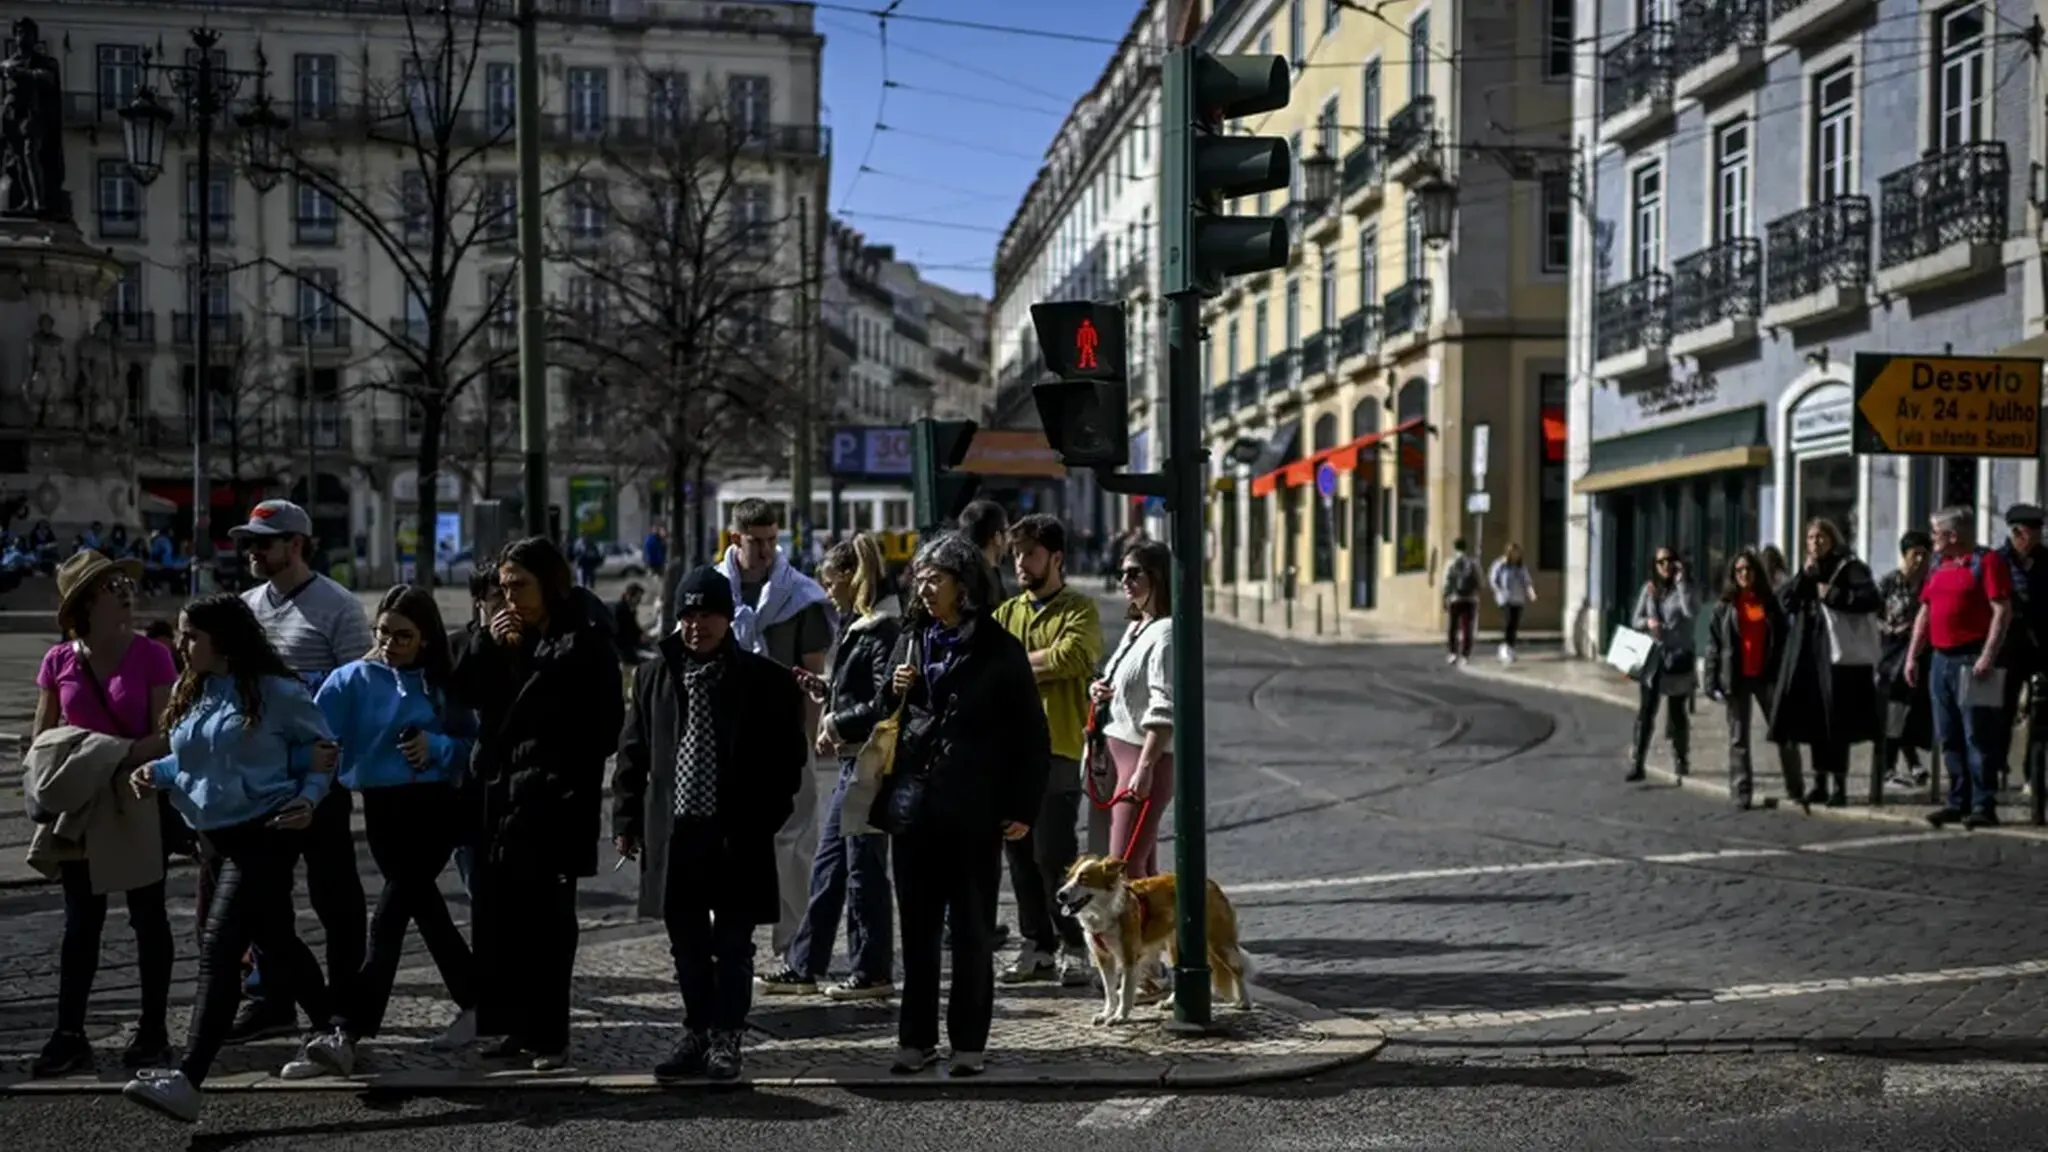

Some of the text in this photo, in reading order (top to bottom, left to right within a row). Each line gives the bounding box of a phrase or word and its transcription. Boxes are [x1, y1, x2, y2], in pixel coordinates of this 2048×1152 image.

[1912, 362, 2022, 393] Desvio
[1896, 397, 1924, 420] Av.
[1933, 397, 1958, 421] 24
[1985, 400, 2035, 422] Julho
[833, 432, 857, 464] P
[1897, 424, 2034, 450] (via Infante Santo)
